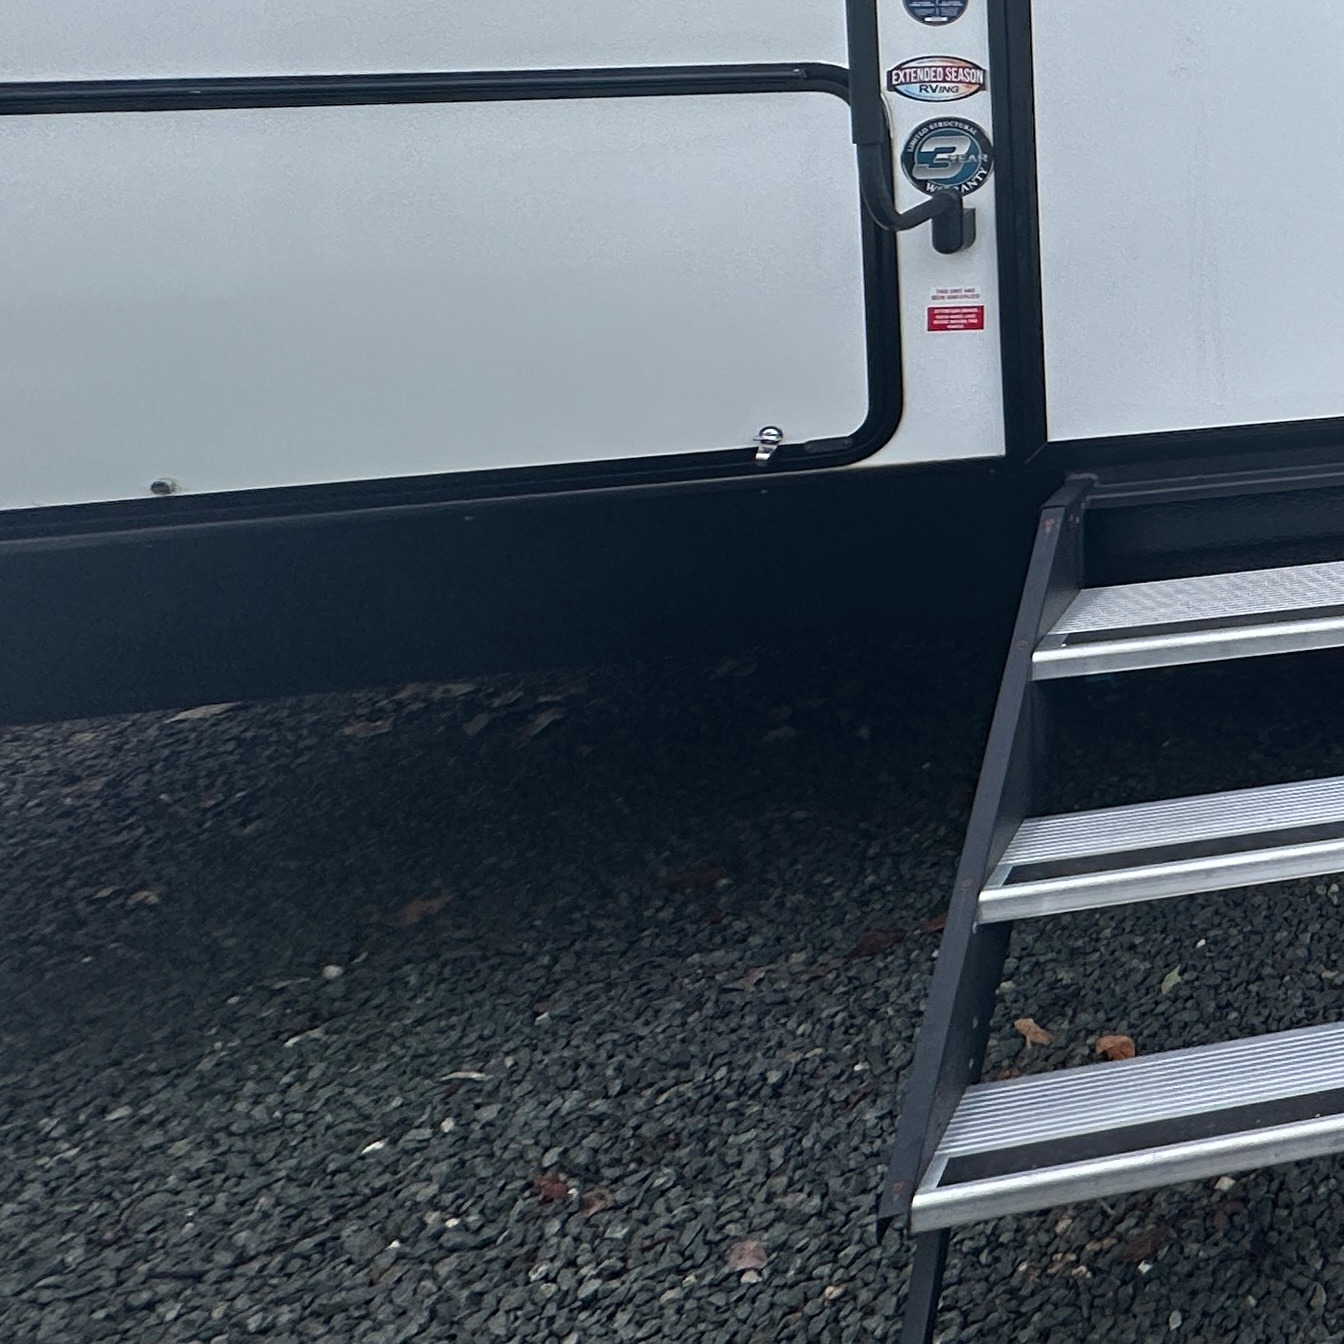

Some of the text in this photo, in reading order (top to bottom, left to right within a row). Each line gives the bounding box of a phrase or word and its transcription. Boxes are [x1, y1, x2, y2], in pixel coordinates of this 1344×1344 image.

[891, 65, 984, 86] EXTENDED SEASON
[912, 135, 972, 180] 3
[926, 167, 988, 193] WANTY
